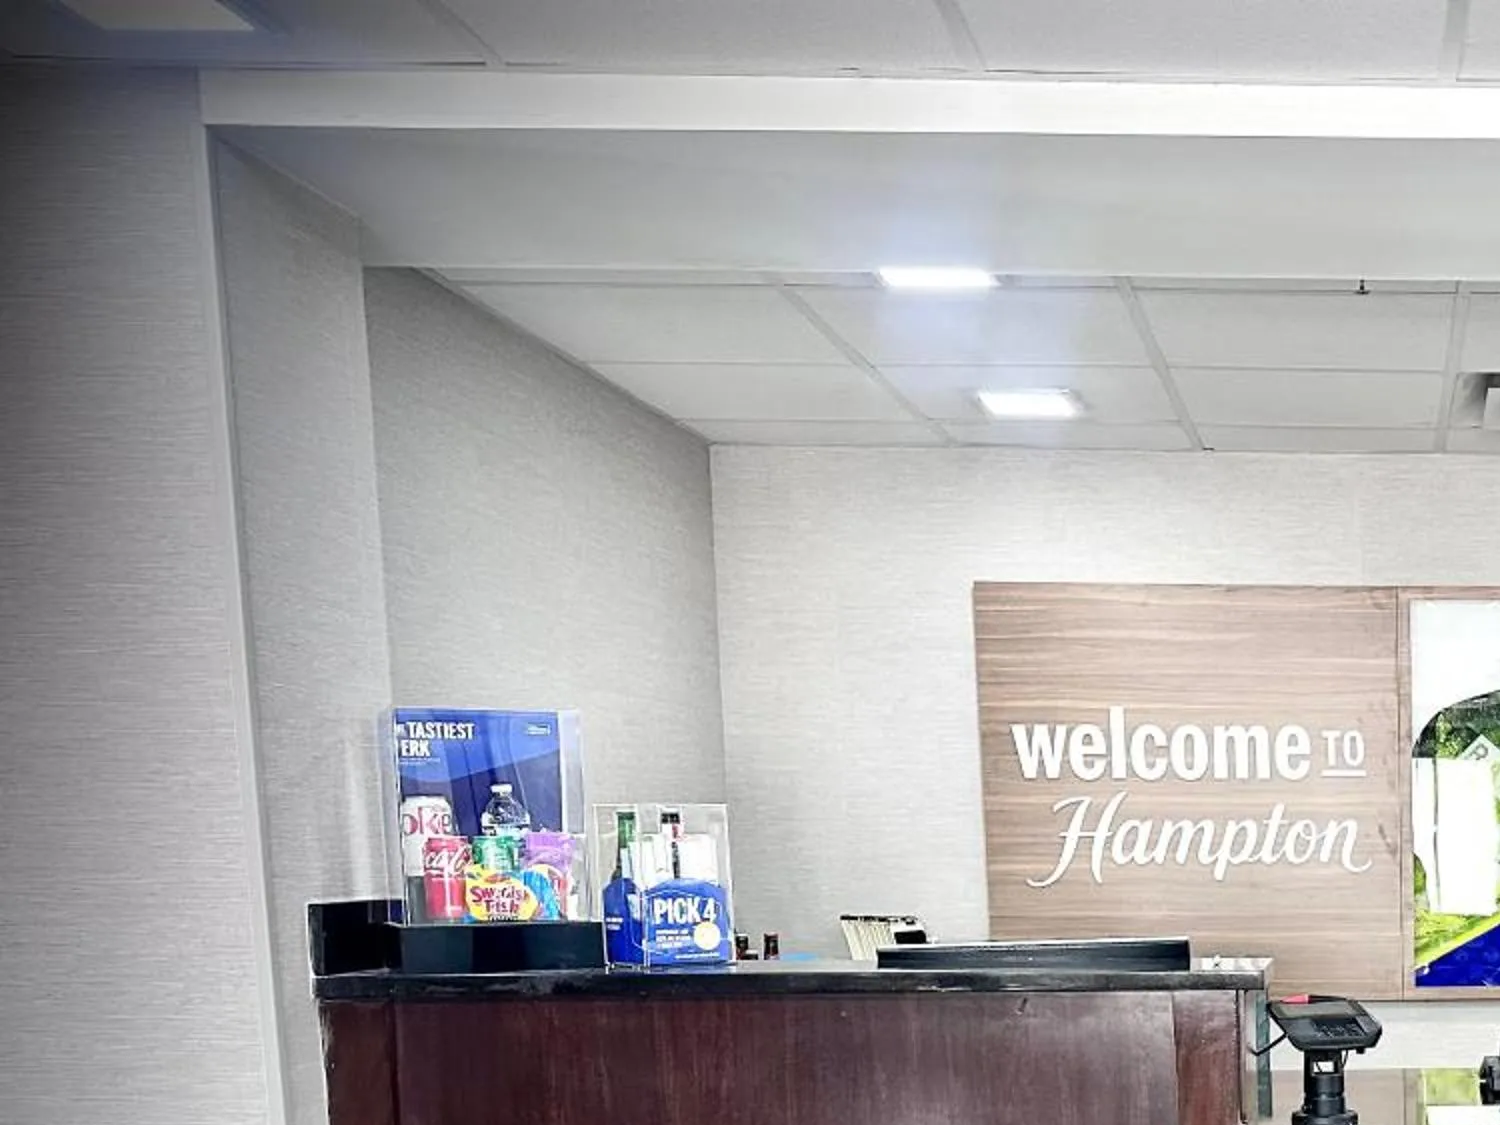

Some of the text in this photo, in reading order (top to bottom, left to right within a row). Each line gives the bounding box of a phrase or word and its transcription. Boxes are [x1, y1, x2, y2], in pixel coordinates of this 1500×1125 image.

[408, 721, 475, 740] TASTIEST
[1010, 706, 1366, 781] welcome TO
[400, 739, 431, 757] ERK
[1026, 791, 1372, 888] Hampton
[653, 896, 701, 924] PICK
[702, 897, 717, 922] 4
